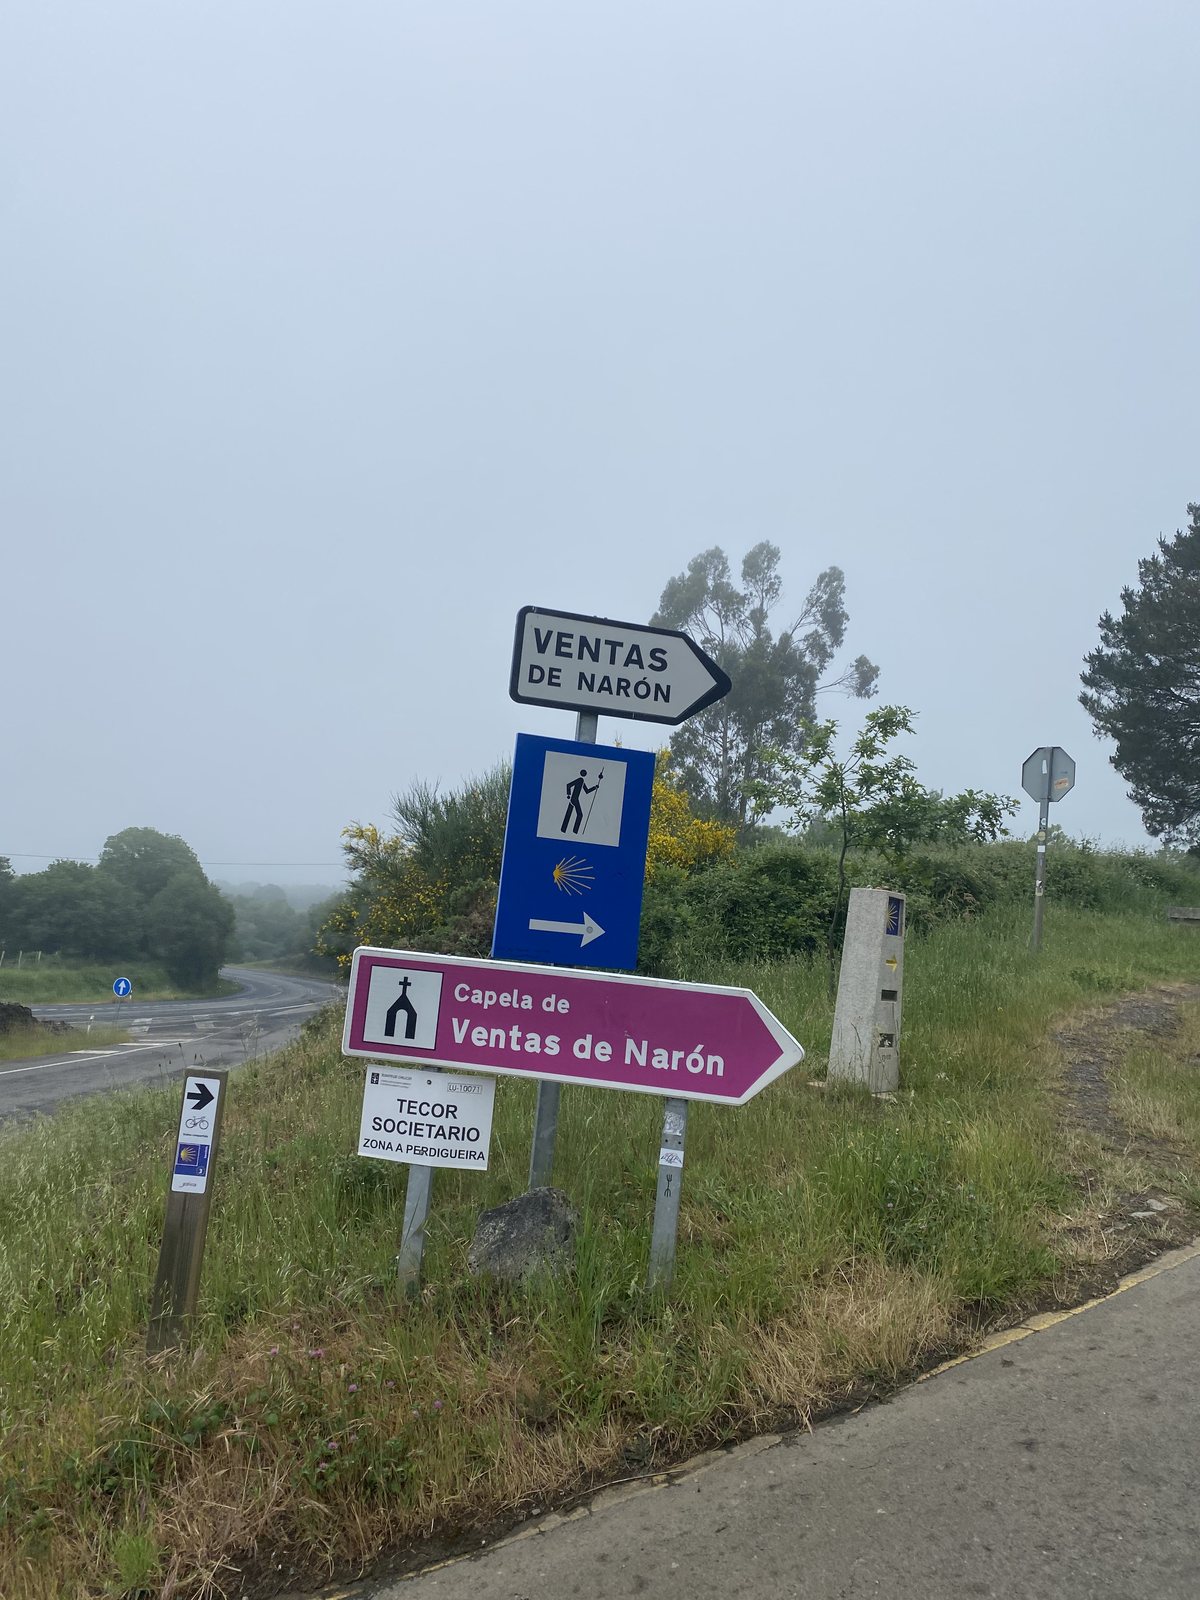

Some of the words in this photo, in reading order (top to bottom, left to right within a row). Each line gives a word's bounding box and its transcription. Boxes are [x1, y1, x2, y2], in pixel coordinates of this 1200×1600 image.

[534, 627, 668, 672] VENTAS
[528, 664, 562, 687] DE
[577, 671, 671, 703] NARÓN
[453, 983, 533, 1011] Capela
[542, 993, 570, 1014] de
[452, 1018, 560, 1056] Ventas
[573, 1033, 613, 1063] de
[624, 1037, 725, 1077] Narón
[448, 1084, 480, 1093] LU-10071
[397, 1098, 458, 1119] TECOR
[372, 1116, 480, 1142] SOCIETARIO
[363, 1138, 393, 1152] ZONA
[395, 1143, 403, 1153] A
[406, 1144, 485, 1161] PERDIGUEIRA
